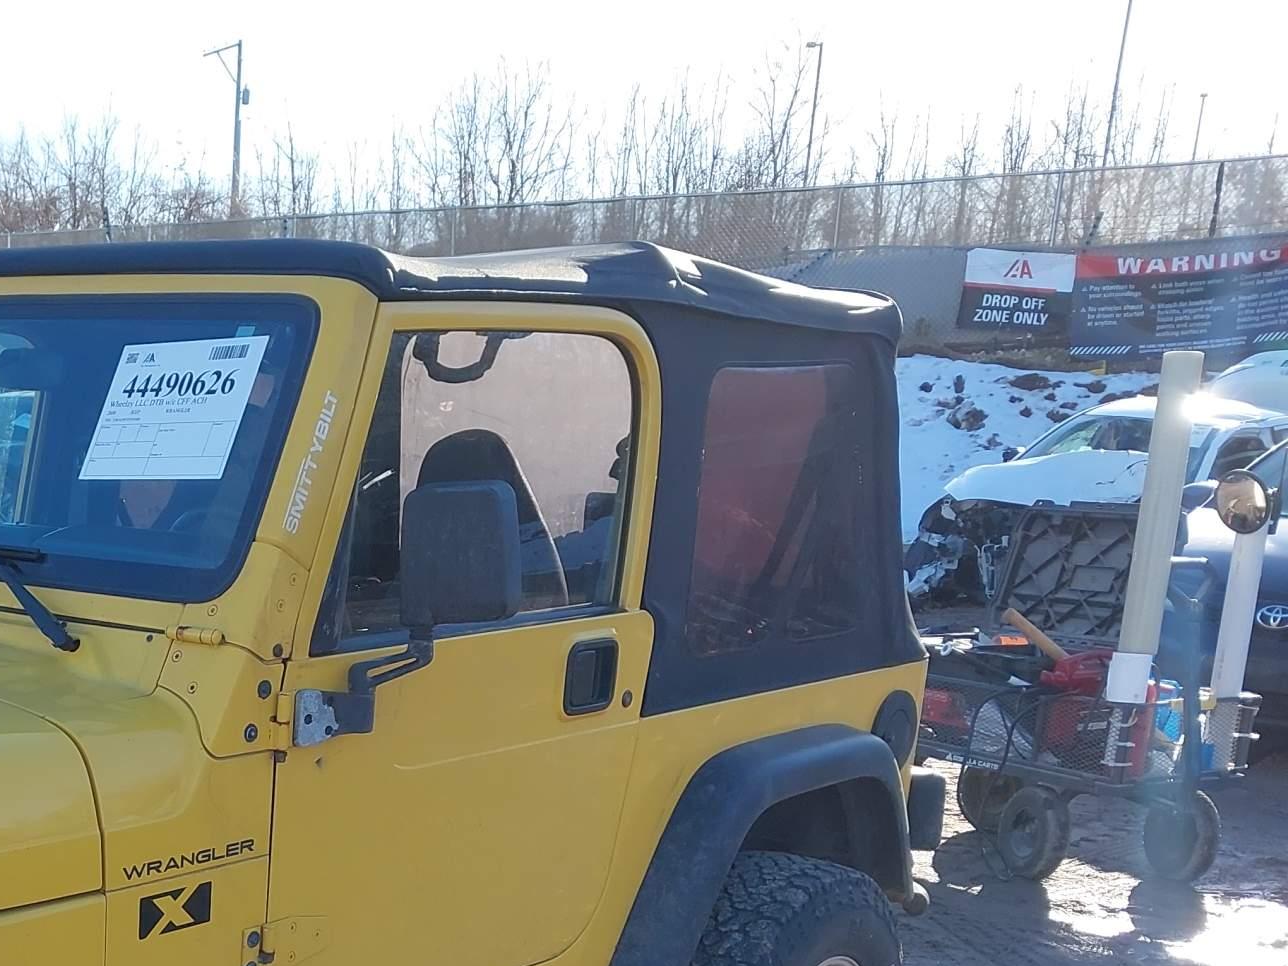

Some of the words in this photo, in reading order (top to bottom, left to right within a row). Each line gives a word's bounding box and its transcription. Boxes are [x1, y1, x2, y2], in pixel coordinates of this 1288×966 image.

[1117, 249, 1281, 275] WARNING
[973, 308, 1011, 323] ZONE
[1013, 311, 1049, 325] ONLY
[982, 294, 1019, 308] DROP
[1022, 296, 1046, 310] OFF
[122, 369, 240, 399] 44490626
[284, 390, 338, 534] SMITTYBILT
[123, 839, 255, 881] WRANGLER
[140, 882, 211, 939] X
